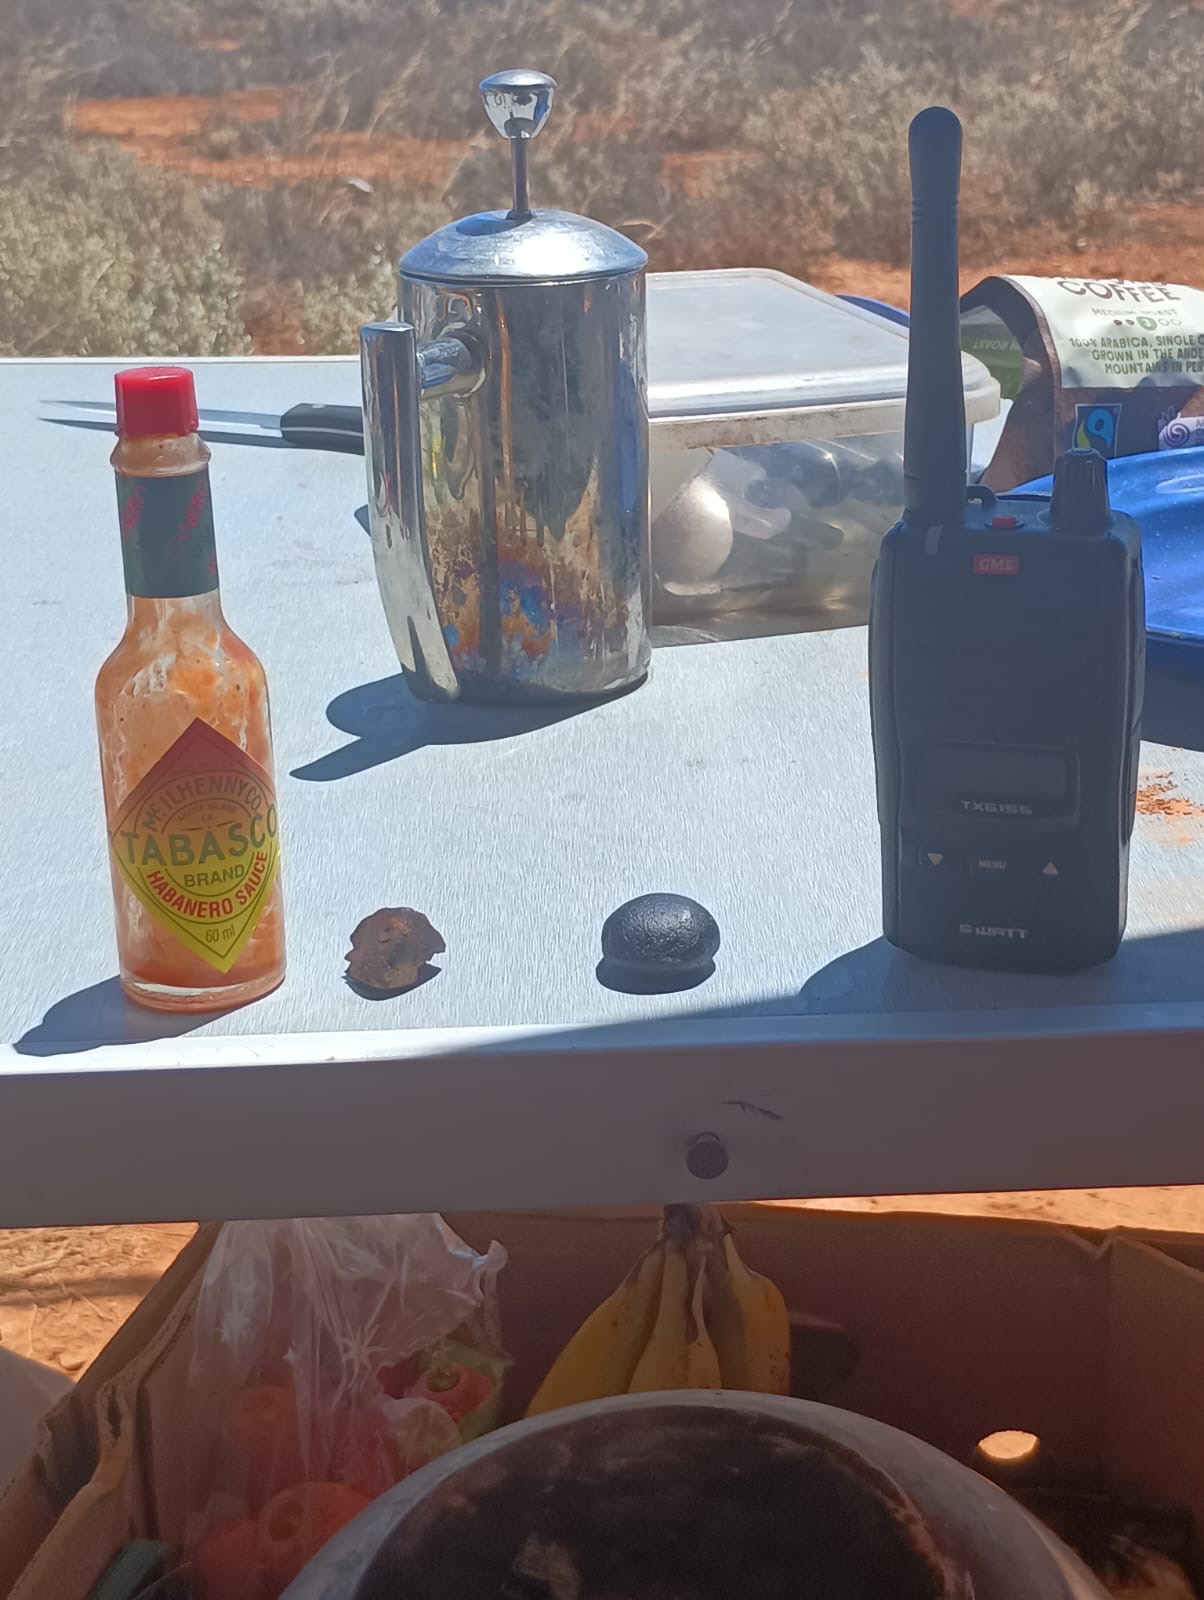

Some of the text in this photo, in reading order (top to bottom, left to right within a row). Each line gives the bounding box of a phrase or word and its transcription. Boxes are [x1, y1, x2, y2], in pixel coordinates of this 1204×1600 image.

[1057, 280, 1181, 303] COFFEE
[1101, 336, 1153, 349] ARABICA,
[1155, 334, 1194, 346] SINGLE
[1092, 347, 1204, 361] GROWN IN THE ANDE
[1104, 361, 1204, 375] MOUNTAINS IN PER
[120, 803, 278, 867] TABASCO
[977, 859, 1006, 870] MENU
[183, 864, 246, 888] BRAND
[146, 851, 268, 919] HABANERO SAUCE
[205, 924, 237, 943] 60 ml
[975, 926, 1029, 939] WATT
